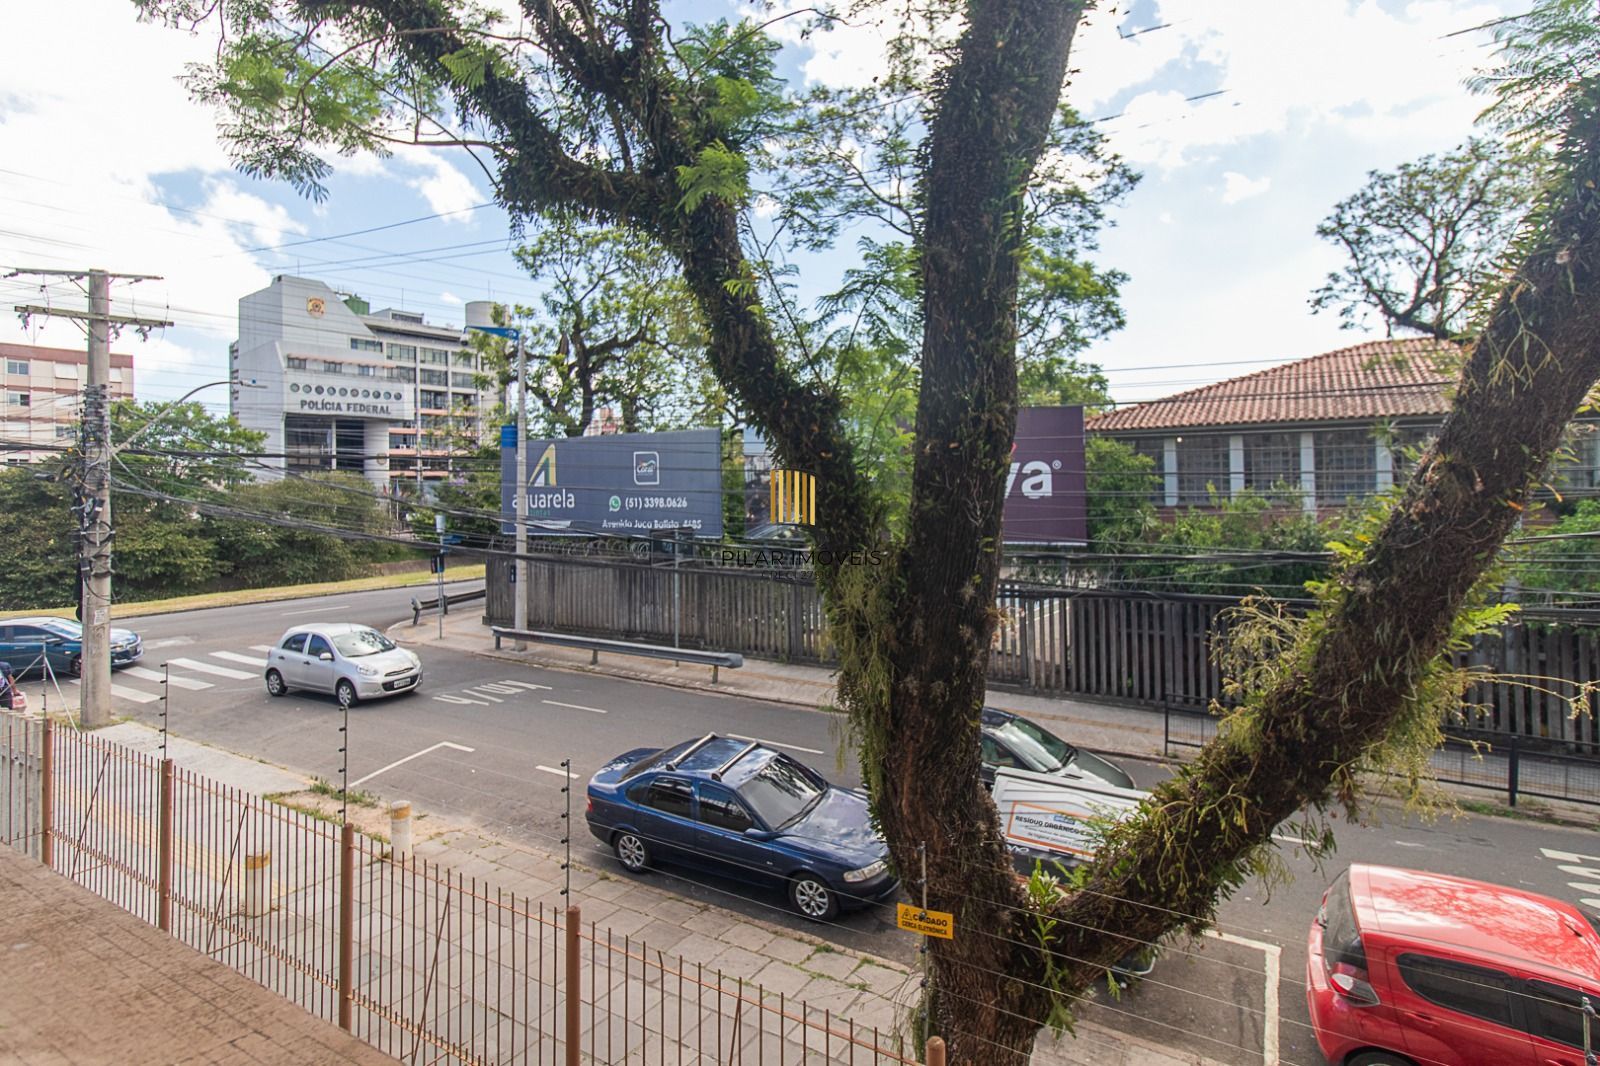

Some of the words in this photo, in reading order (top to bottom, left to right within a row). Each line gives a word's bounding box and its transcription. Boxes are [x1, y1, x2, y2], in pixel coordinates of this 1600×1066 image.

[300, 399, 342, 411] POLÍCIA
[346, 403, 391, 415] FEDERAL
[512, 489, 575, 516] auarela
[625, 497, 642, 510] (51)
[644, 497, 688, 508] 3398.0626
[602, 519, 632, 528] Avenida
[634, 520, 652, 529] Juca
[1015, 815, 1043, 827] RESÍDUO
